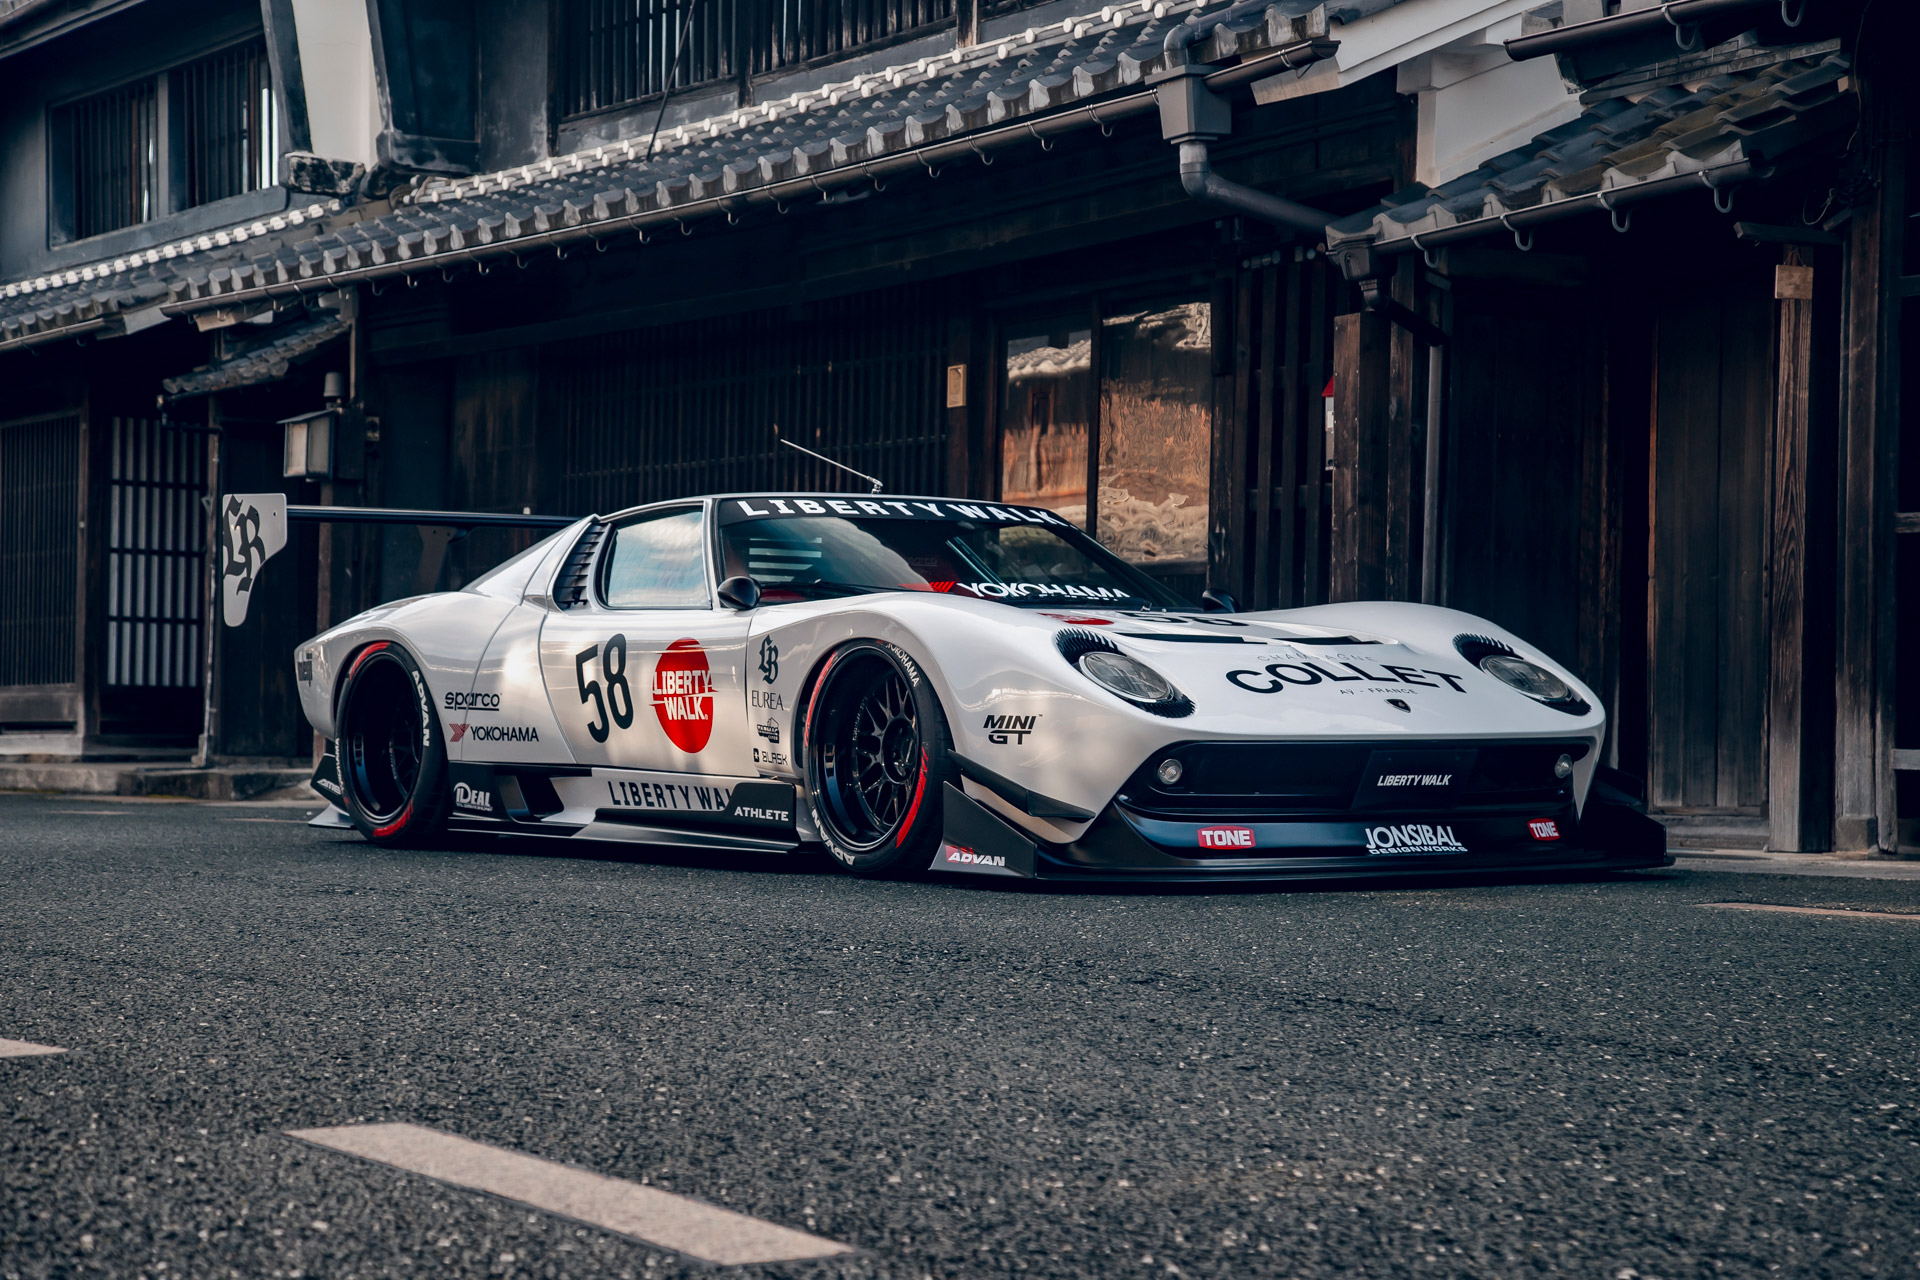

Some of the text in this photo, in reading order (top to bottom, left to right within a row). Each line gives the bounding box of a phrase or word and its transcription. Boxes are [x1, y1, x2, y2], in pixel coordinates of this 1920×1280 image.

[738, 499, 945, 517] LIBERTY
[652, 669, 713, 695] LIBERTY
[1225, 661, 1467, 695] COLLET
[575, 633, 634, 743] 58
[1368, 687, 1419, 695] FRANCE
[411, 670, 430, 747] ADVAN
[444, 691, 501, 711] sparco
[751, 690, 784, 711] EUREA
[470, 726, 540, 742] YOKOHAMA
[988, 729, 1032, 745] GT
[1377, 774, 1452, 787] LIBERTY WALK
[607, 780, 691, 810] LIBERTY
[734, 806, 789, 822] ATHLETE
[811, 808, 856, 866] ADVAN
[1201, 830, 1252, 847] TONE
[1364, 824, 1462, 849] JONSIBAL
[1529, 821, 1559, 839] TONE
[948, 852, 1006, 867] ADVAN
[1369, 846, 1468, 855] DESIGNWORKS
